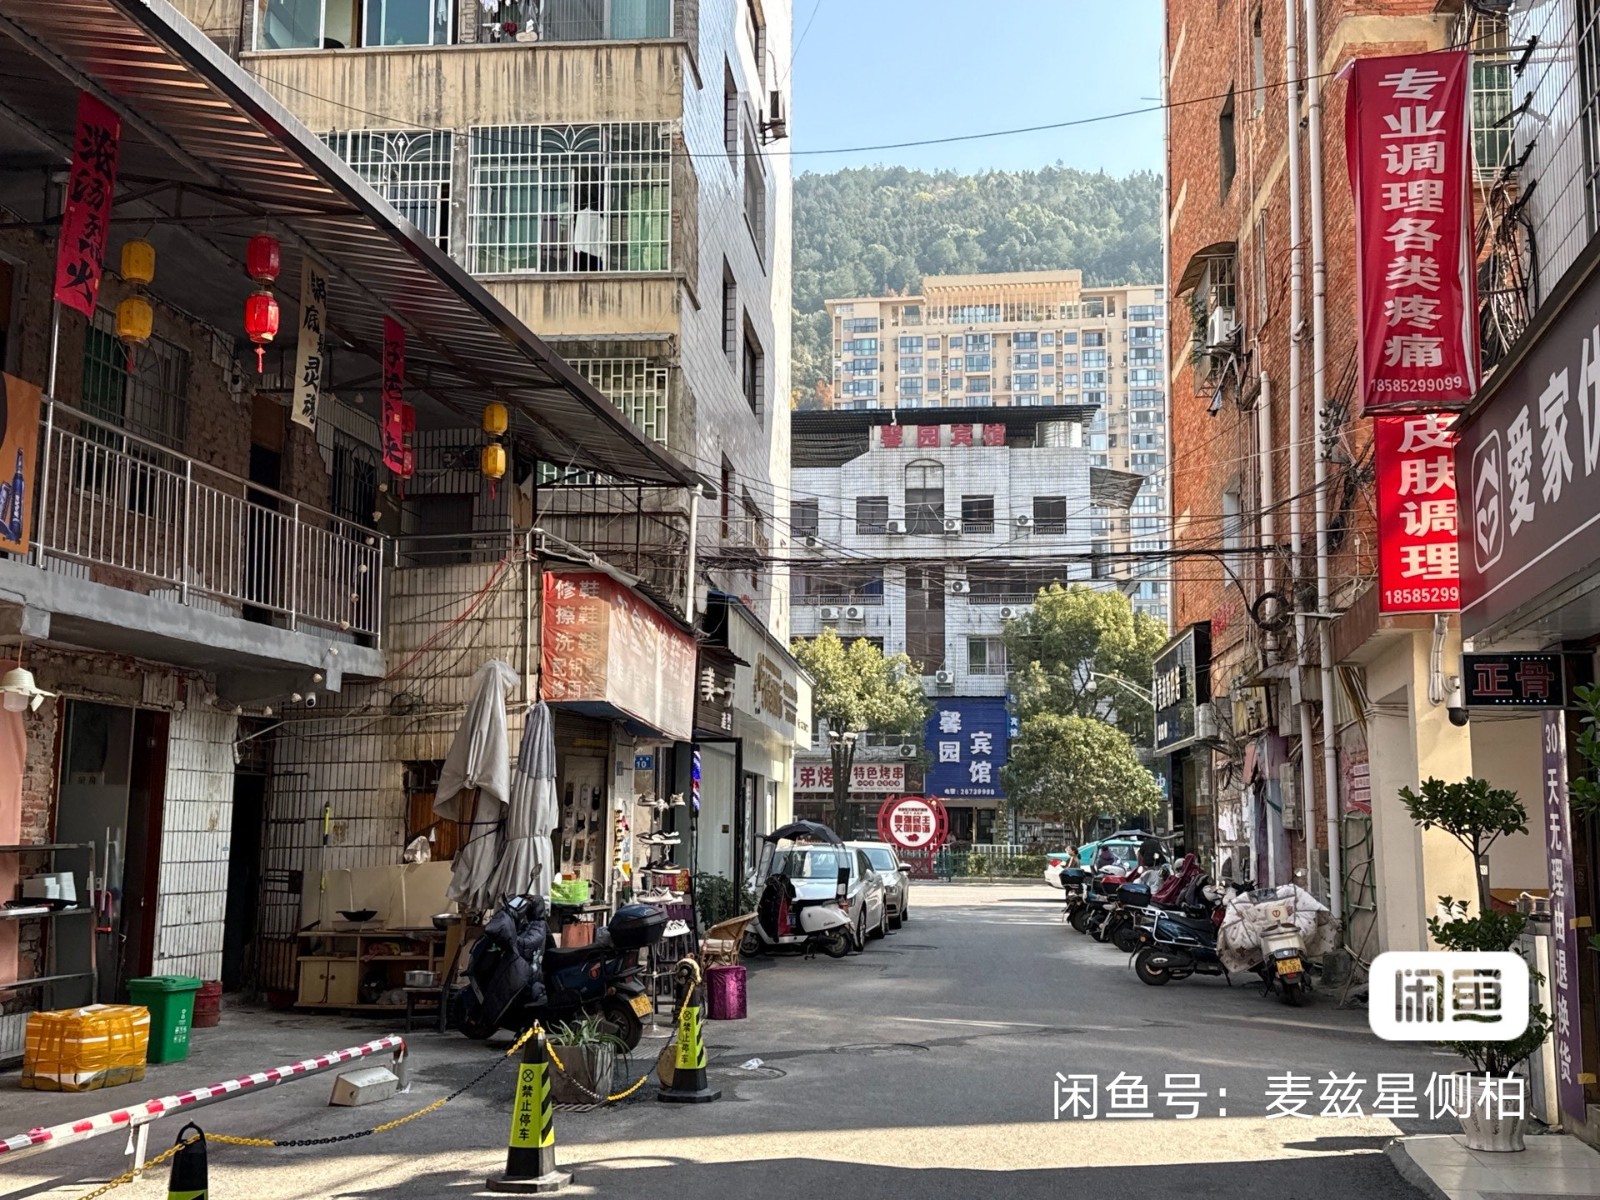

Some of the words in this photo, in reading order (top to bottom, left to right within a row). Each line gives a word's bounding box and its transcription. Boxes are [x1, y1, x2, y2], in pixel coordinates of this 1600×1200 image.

[1378, 67, 1447, 368] 专业调理各类疼痛
[1370, 376, 1462, 394] 18585299099
[1398, 414, 1459, 580] 皮肤调理
[555, 579, 600, 600] 修鞋
[1385, 586, 1459, 605] 18585299
[555, 605, 599, 625] 擦鞋
[554, 632, 596, 651] 洗鞋
[552, 657, 600, 677] 配钥匙
[551, 680, 597, 698] 修雨伞
[1472, 661, 1555, 699] 正骨
[939, 710, 962, 763] 馨园
[969, 731, 992, 784] 宾馆
[794, 766, 852, 788] 弟烤
[853, 765, 904, 780] 特色烤串
[1545, 723, 1572, 1085] 30天无理由退换货
[680, 1021, 692, 1064] 禁止停车
[518, 1084, 534, 1141] 禁止停车
